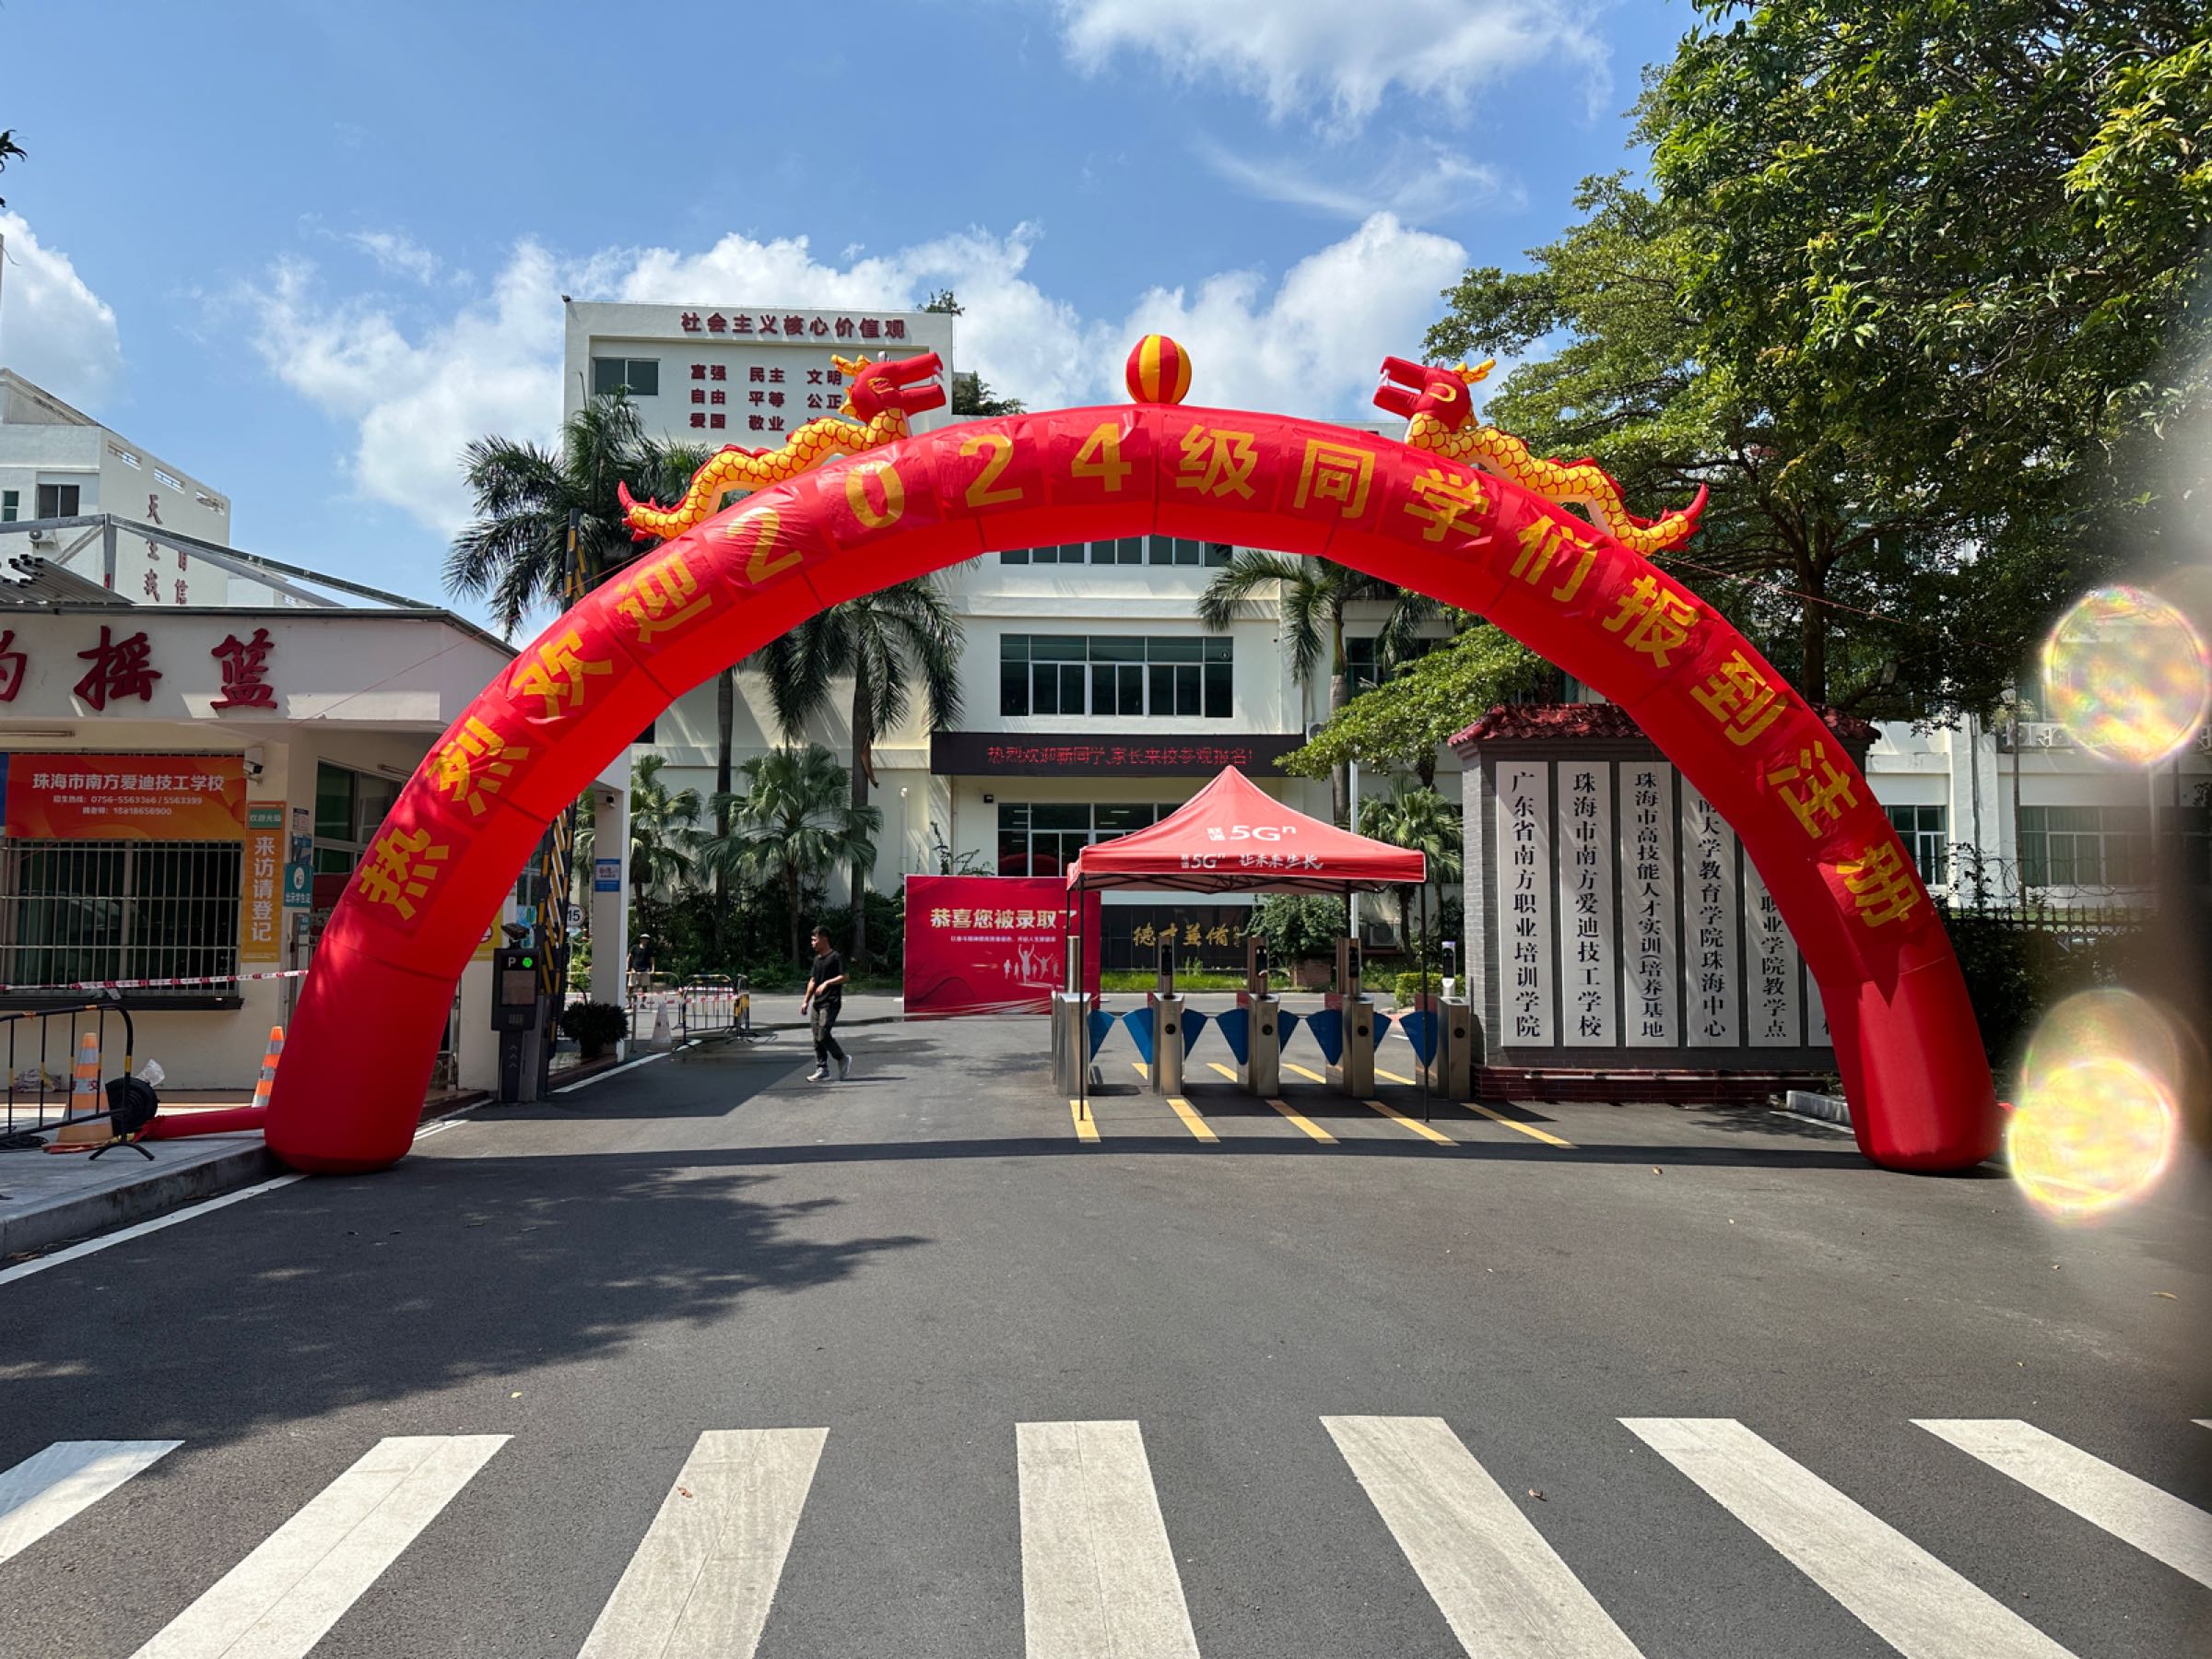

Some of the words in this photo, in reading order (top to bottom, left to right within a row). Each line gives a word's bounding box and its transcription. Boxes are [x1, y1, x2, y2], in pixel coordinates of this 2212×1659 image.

[682, 312, 905, 339] 社会主义核心价值观
[690, 364, 726, 382] 富强
[748, 367, 785, 383] 民主
[806, 369, 842, 385] 文明
[691, 388, 726, 406] 自由
[748, 390, 785, 408] 平等
[806, 393, 842, 409] 公正
[690, 412, 726, 429] 爱国
[748, 414, 784, 432] 敬业
[32, 773, 226, 792] 珠海市南方爱迪技工学校
[251, 835, 276, 943] 来访请登记
[1512, 771, 1541, 1038] 广东省南方职业培训学院
[1572, 771, 1602, 1037] 珠海市南方爱迪技工学校
[1634, 771, 1665, 1037] 珠海市高技能人才实训(培养)基地
[567, 910, 581, 922] 15
[930, 908, 1077, 929] 恭喜您被录取了
[508, 957, 517, 968] P
[1759, 887, 1787, 1038] 职业学院教学点
